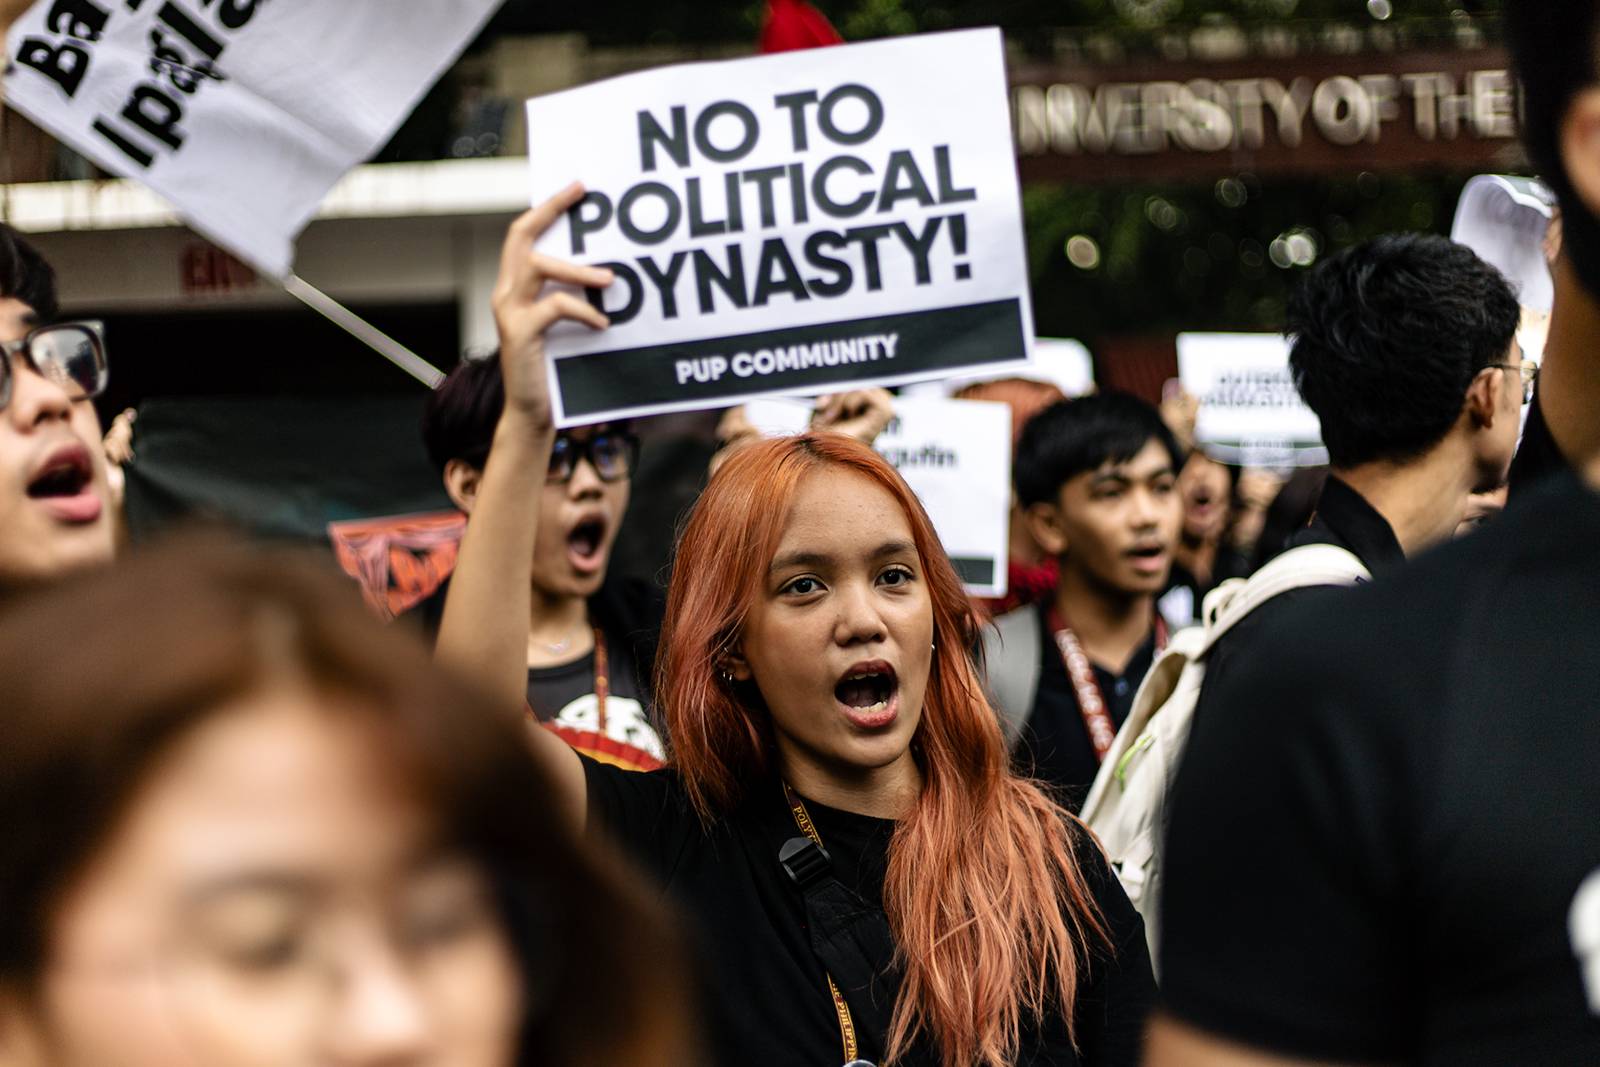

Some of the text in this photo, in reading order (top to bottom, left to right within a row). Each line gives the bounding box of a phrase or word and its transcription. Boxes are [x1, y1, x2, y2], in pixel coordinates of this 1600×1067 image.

[16, 0, 142, 97] Ba
[637, 83, 884, 172] NO TO
[1012, 69, 1517, 155] NIVERSITY OF THE
[566, 144, 976, 255] POLITICAL
[583, 212, 972, 326] DYNASTY!
[675, 333, 898, 384] PUP COMMUNITY
[793, 806, 818, 843] POLYT
[837, 1001, 857, 1064] PHILIPPIN
